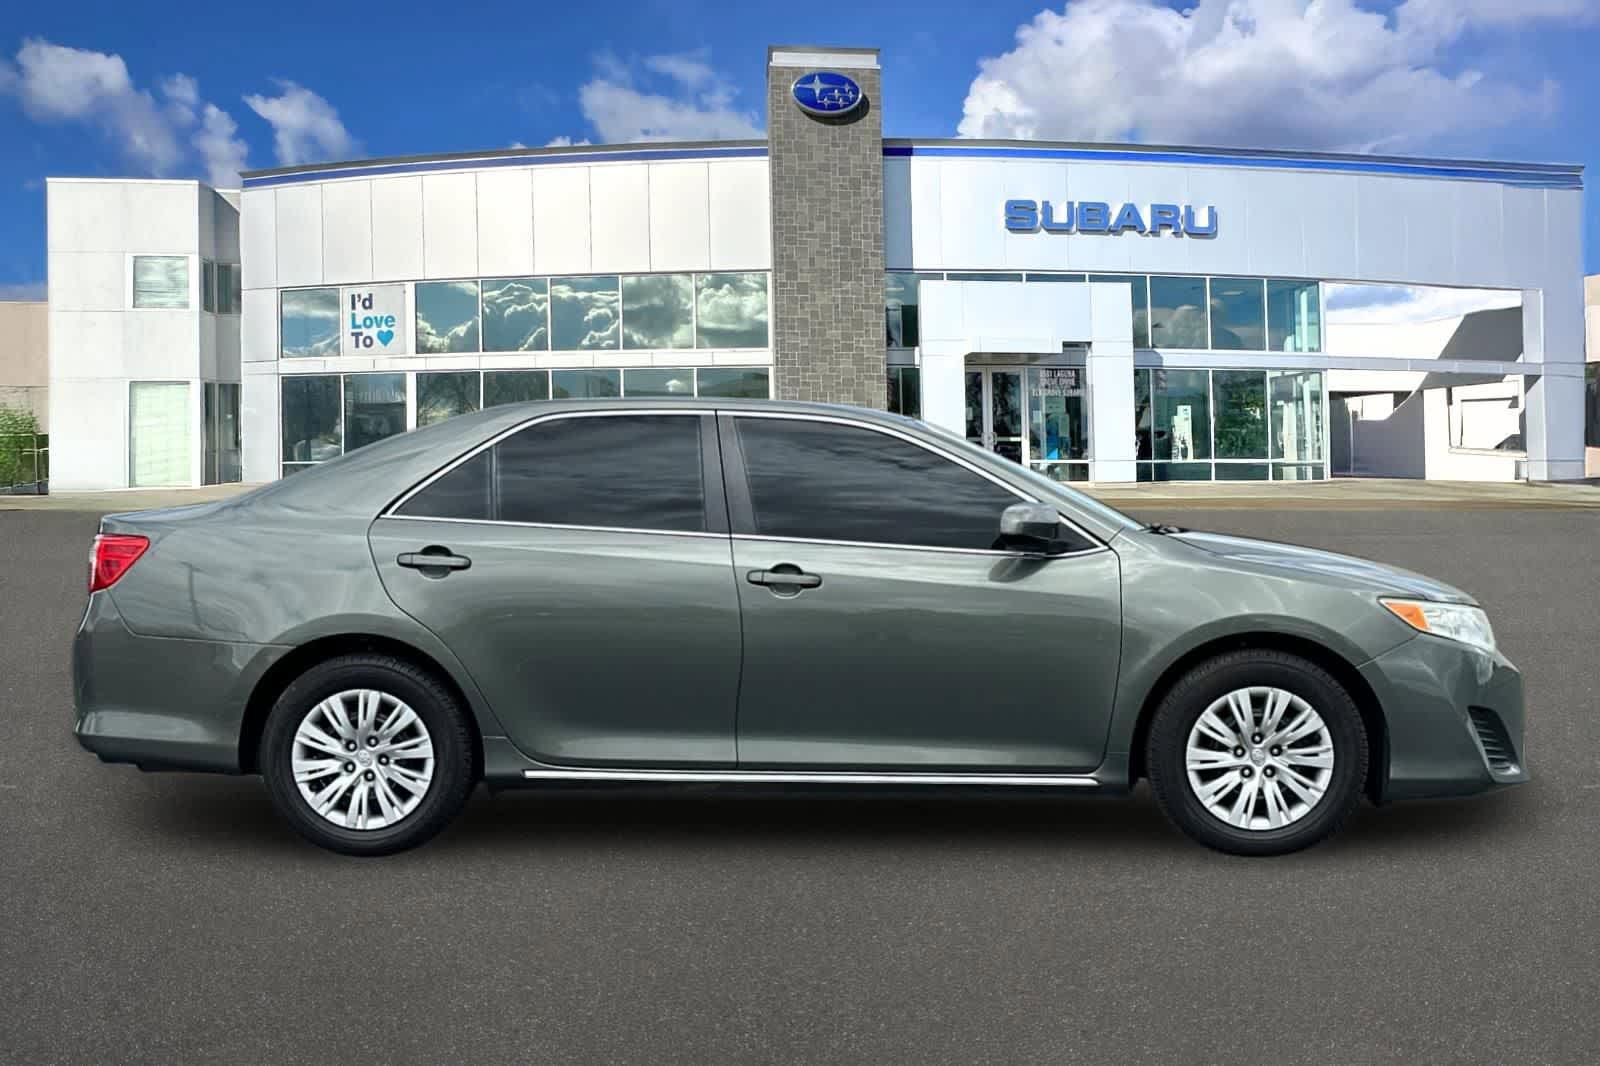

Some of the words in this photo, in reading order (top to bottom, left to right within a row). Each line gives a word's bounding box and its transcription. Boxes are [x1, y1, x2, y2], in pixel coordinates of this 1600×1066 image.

[1005, 199, 1217, 237] SUBARU
[351, 312, 396, 329] Love
[351, 331, 373, 348] To
